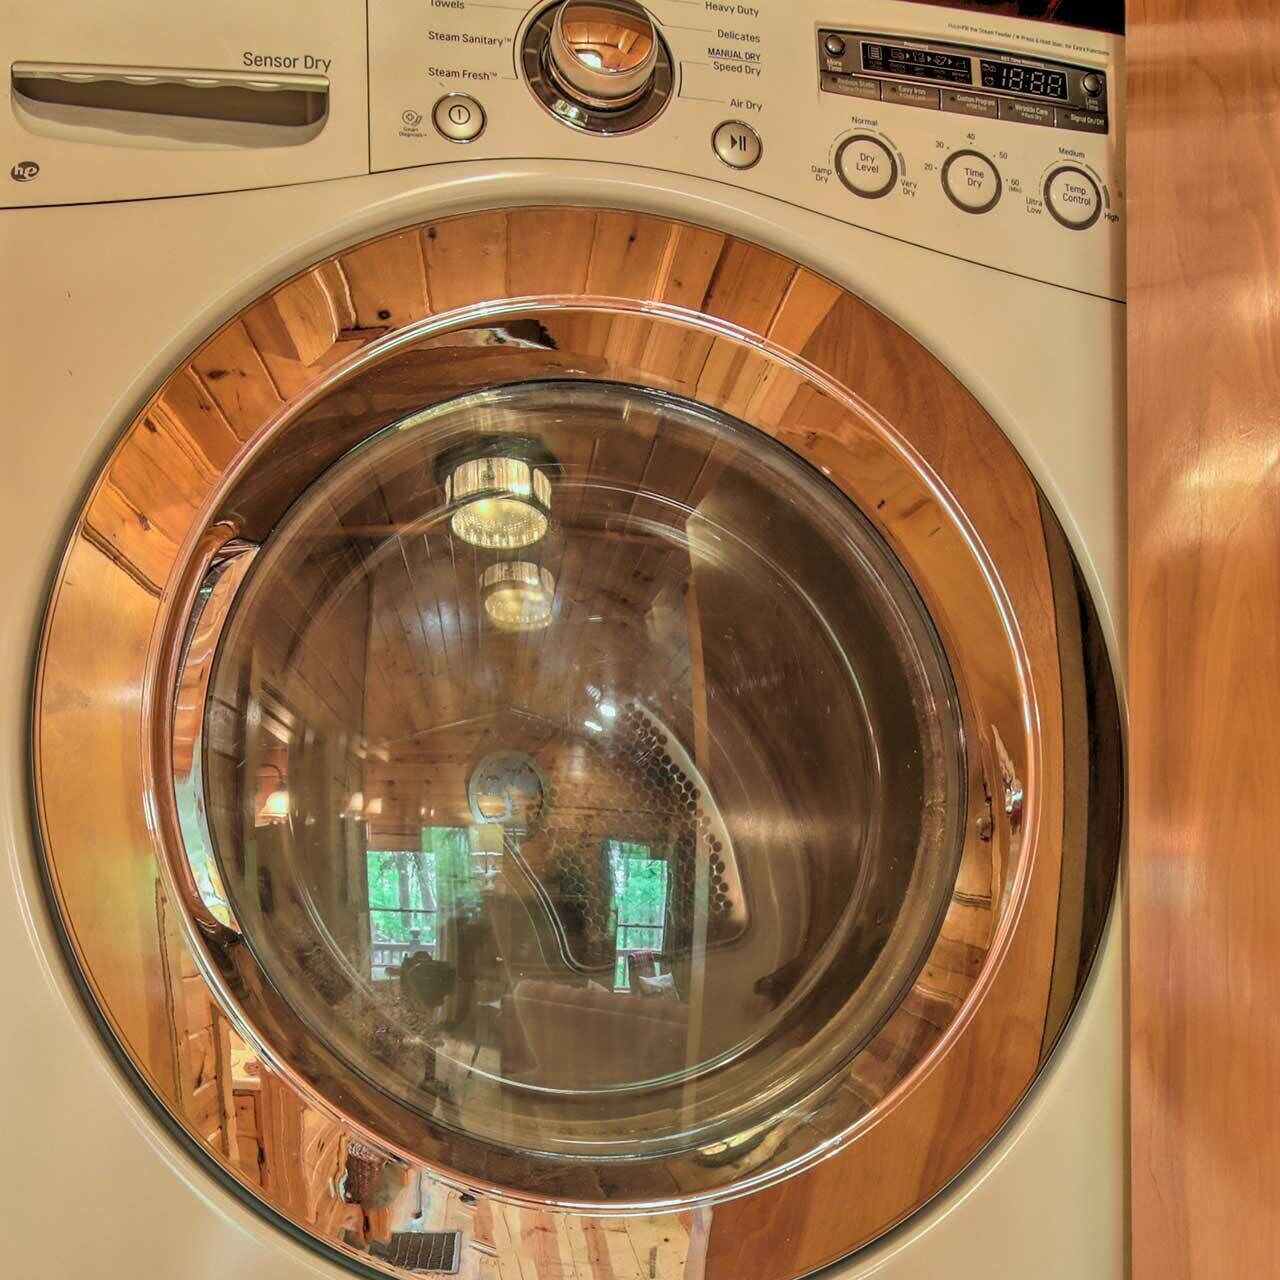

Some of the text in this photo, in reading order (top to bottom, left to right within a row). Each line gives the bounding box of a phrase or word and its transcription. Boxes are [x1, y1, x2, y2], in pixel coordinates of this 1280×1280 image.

[705, 1, 759, 18] Heavy Duty
[428, 31, 460, 42] Steam
[717, 29, 761, 43] Delicates
[708, 48, 761, 61] MANUAL DRY
[243, 52, 332, 73] Sensor Dry
[428, 67, 460, 78] Steam
[713, 61, 761, 76] Speed Dry
[730, 99, 763, 112] Air Dry
[852, 117, 878, 126] Normal
[860, 153, 875, 163] Dry
[1059, 147, 1085, 158] Medium
[811, 165, 832, 175] Damp
[856, 162, 879, 173] Level
[924, 163, 933, 171] 20
[815, 174, 828, 183] Dry
[964, 168, 985, 178] Time
[901, 179, 917, 189] Very
[967, 178, 983, 189] Dry
[903, 187, 915, 197] Dry
[1026, 197, 1043, 206] Ultra
[1062, 193, 1091, 206] Control
[1026, 206, 1041, 214] Low
[1104, 212, 1120, 223] High
